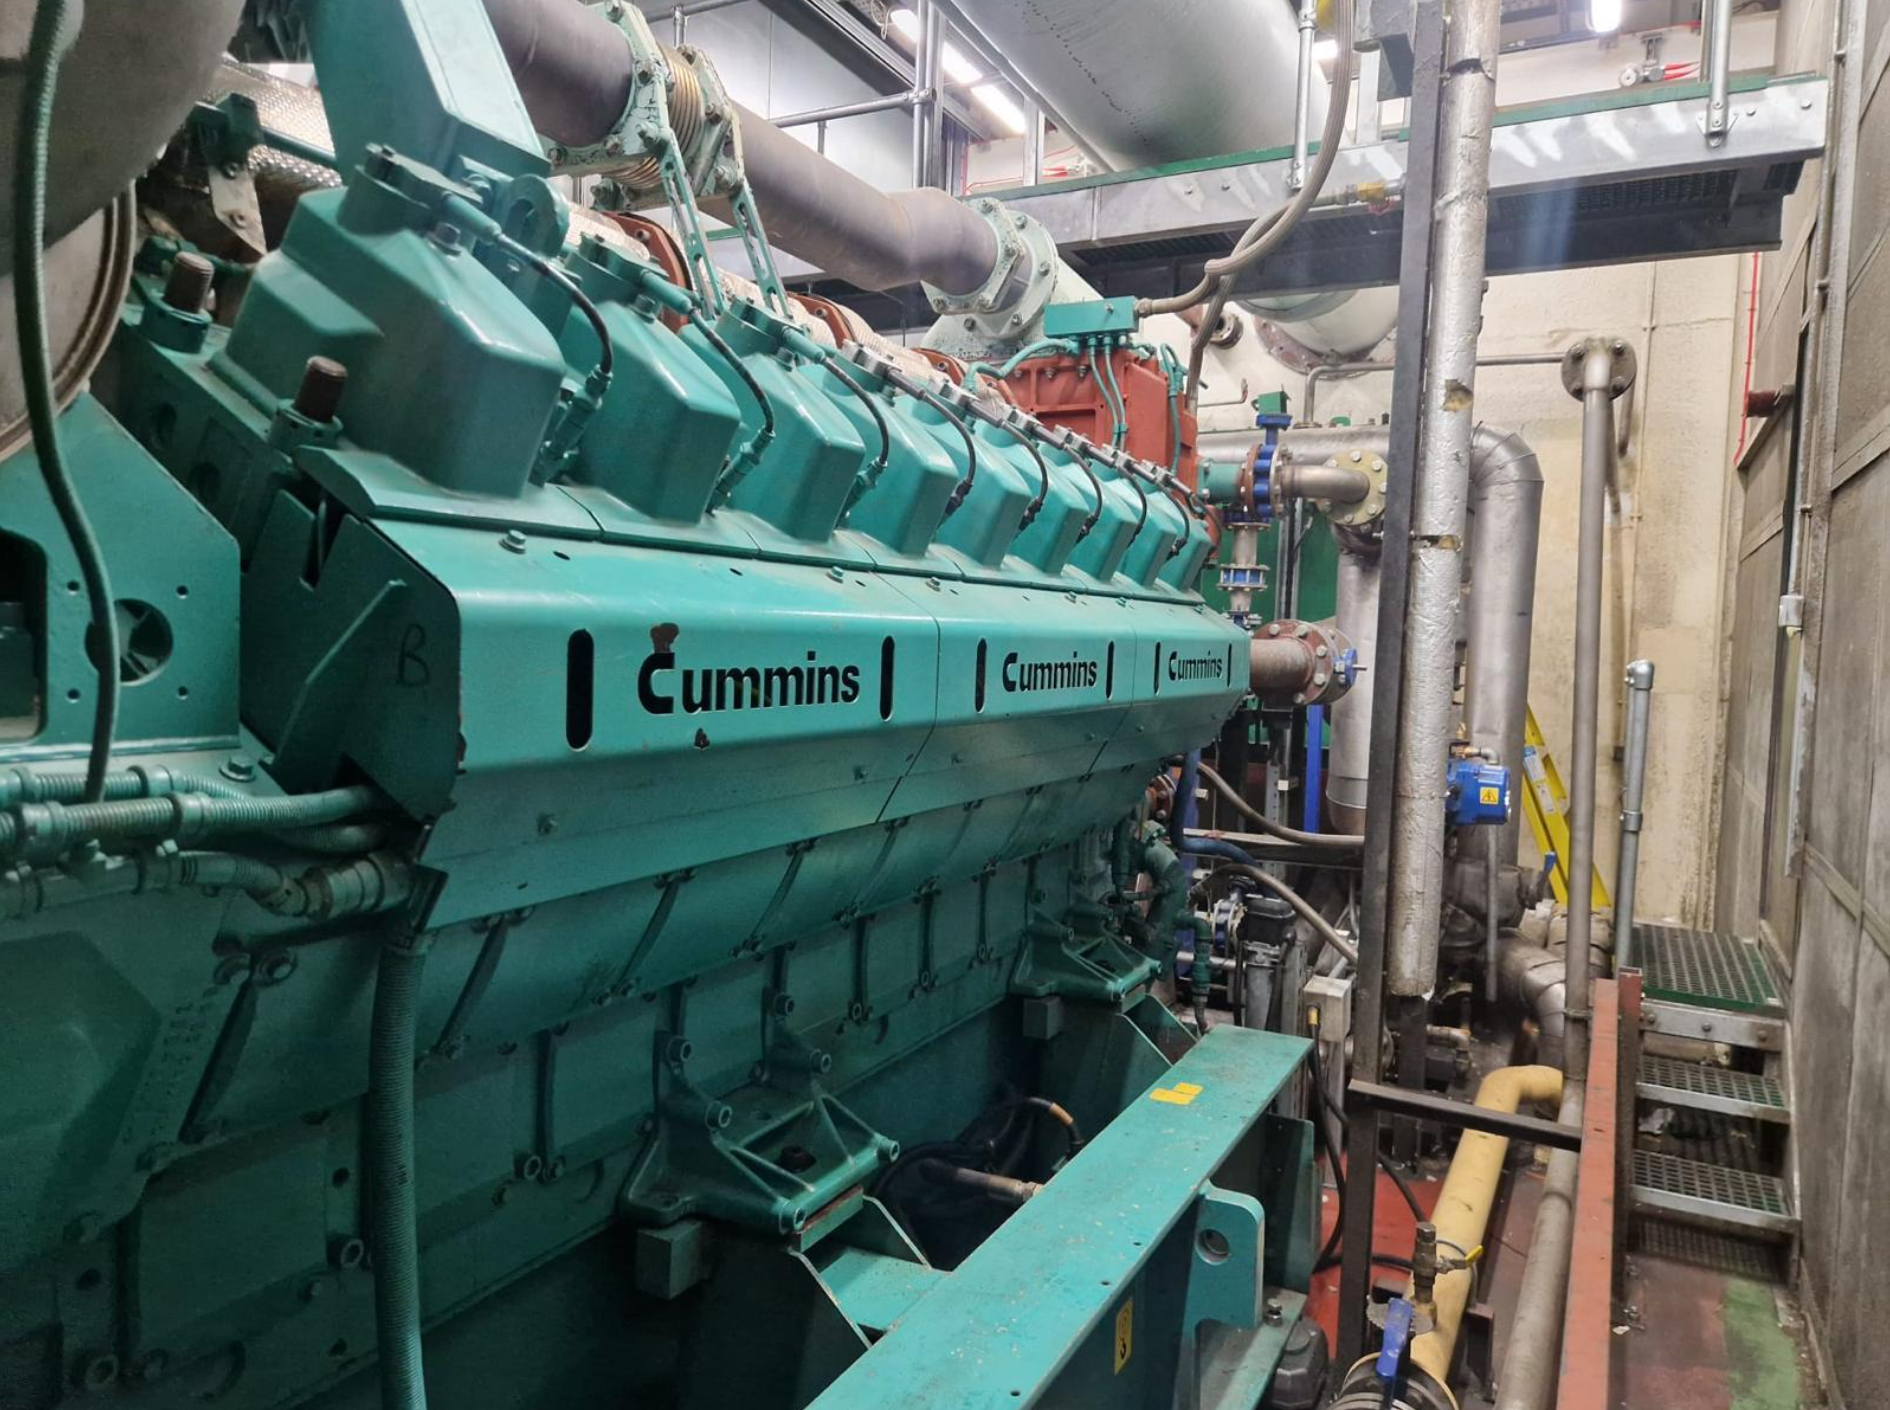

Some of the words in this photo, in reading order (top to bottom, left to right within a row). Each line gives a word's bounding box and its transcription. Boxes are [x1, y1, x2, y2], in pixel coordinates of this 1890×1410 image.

[398, 623, 430, 687] B
[1002, 651, 1098, 692] Cummins
[1168, 651, 1223, 681] Cummins
[638, 651, 860, 714] Cummins
